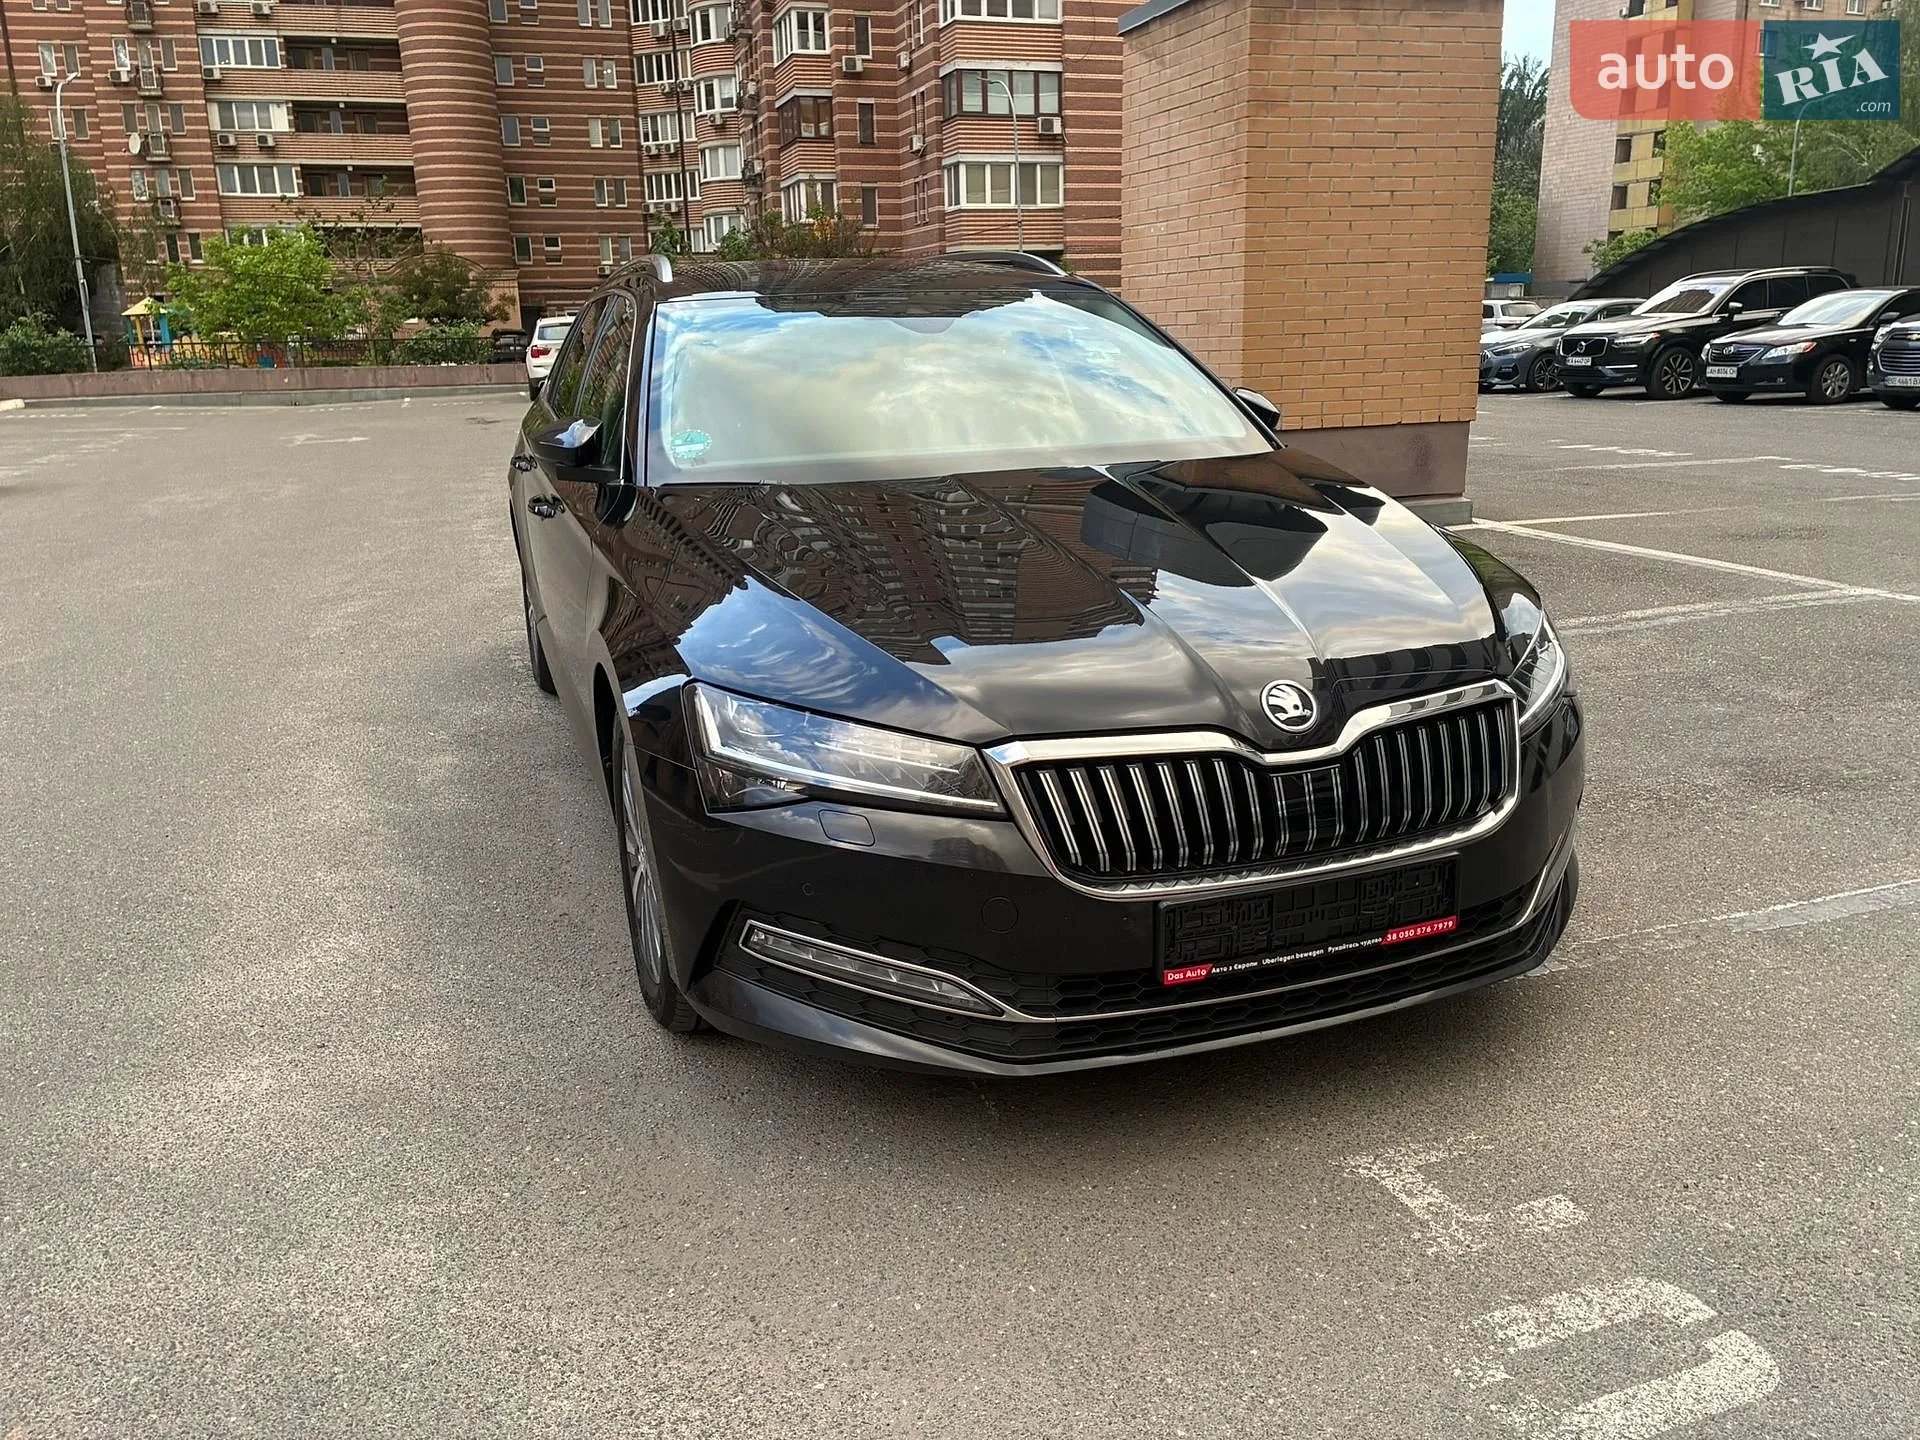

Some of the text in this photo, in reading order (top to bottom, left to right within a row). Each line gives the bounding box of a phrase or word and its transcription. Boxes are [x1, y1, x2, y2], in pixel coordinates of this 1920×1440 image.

[1387, 920, 1453, 942] 38 050 576 7979
[1167, 969, 1206, 981] Das Auto
